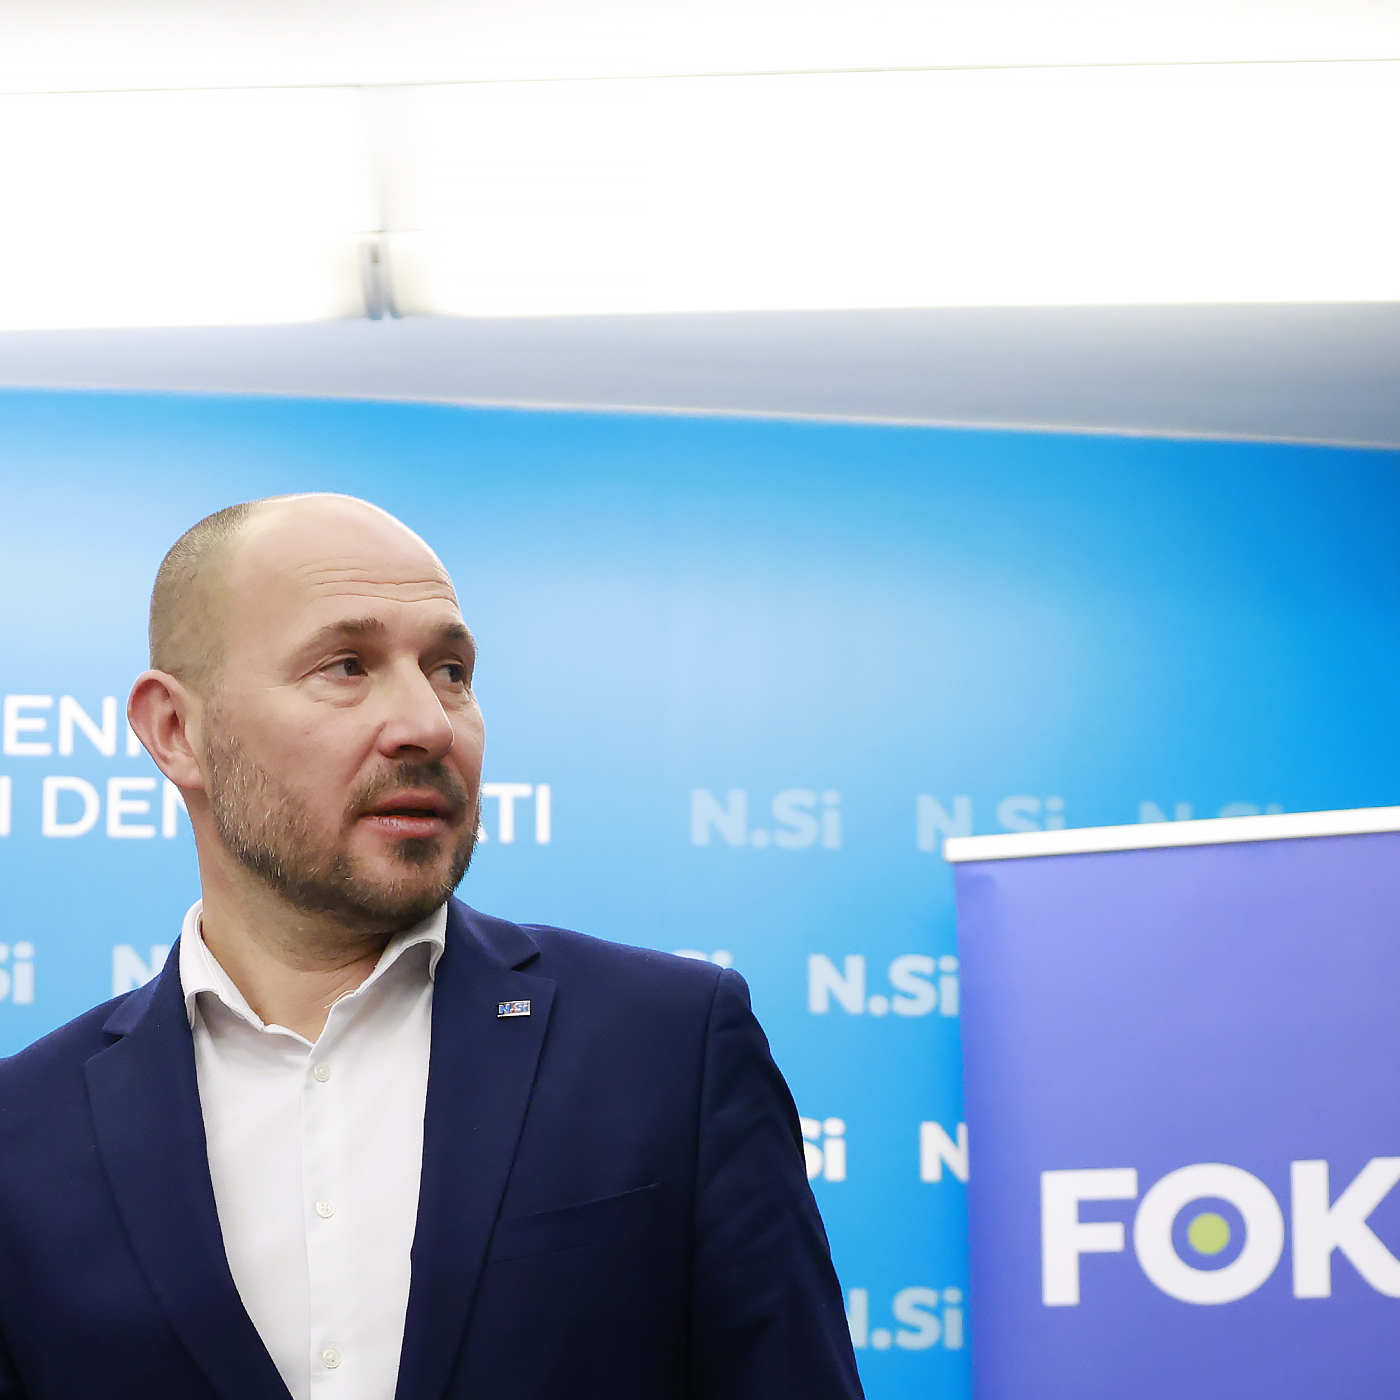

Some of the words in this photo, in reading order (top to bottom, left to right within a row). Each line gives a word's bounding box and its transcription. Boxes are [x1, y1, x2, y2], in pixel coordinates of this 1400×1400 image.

[689, 788, 842, 851] N.Si
[916, 794, 1066, 853] NSi
[498, 1002, 530, 1015] N.Si
[807, 953, 960, 1018] N.Si
